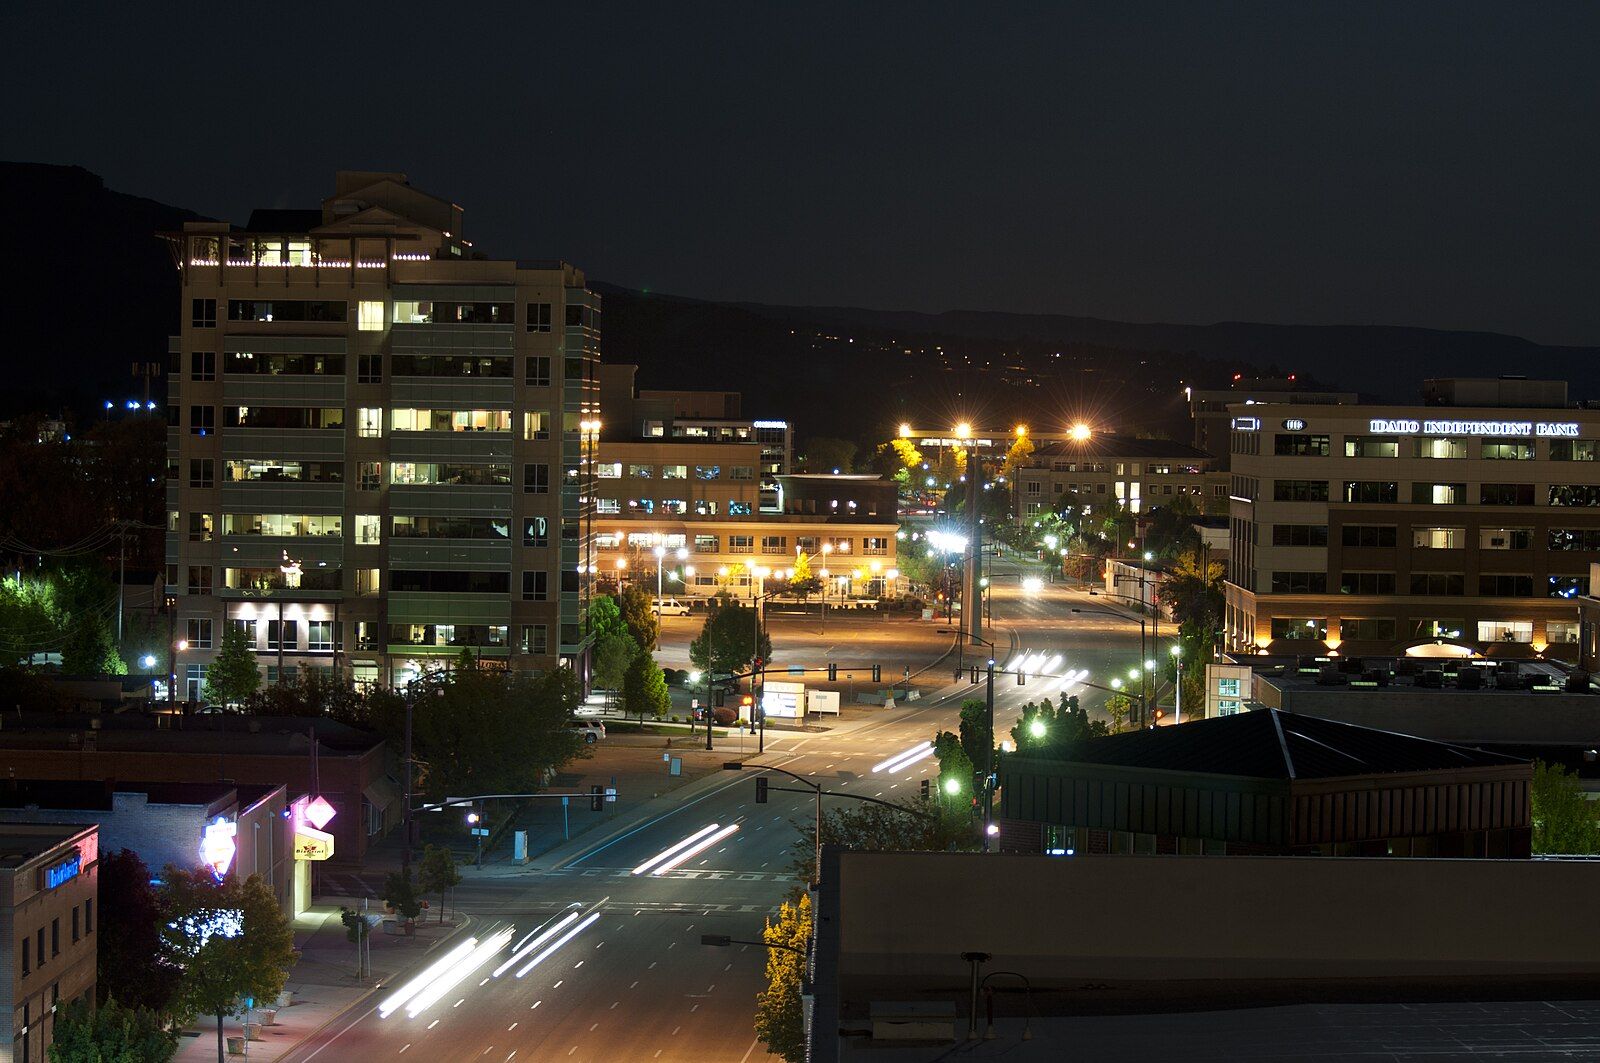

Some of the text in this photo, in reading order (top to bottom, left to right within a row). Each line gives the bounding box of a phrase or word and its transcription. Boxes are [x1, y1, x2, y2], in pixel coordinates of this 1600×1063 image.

[1370, 420, 1579, 436] IDAHO INDEPENDENT BANK
